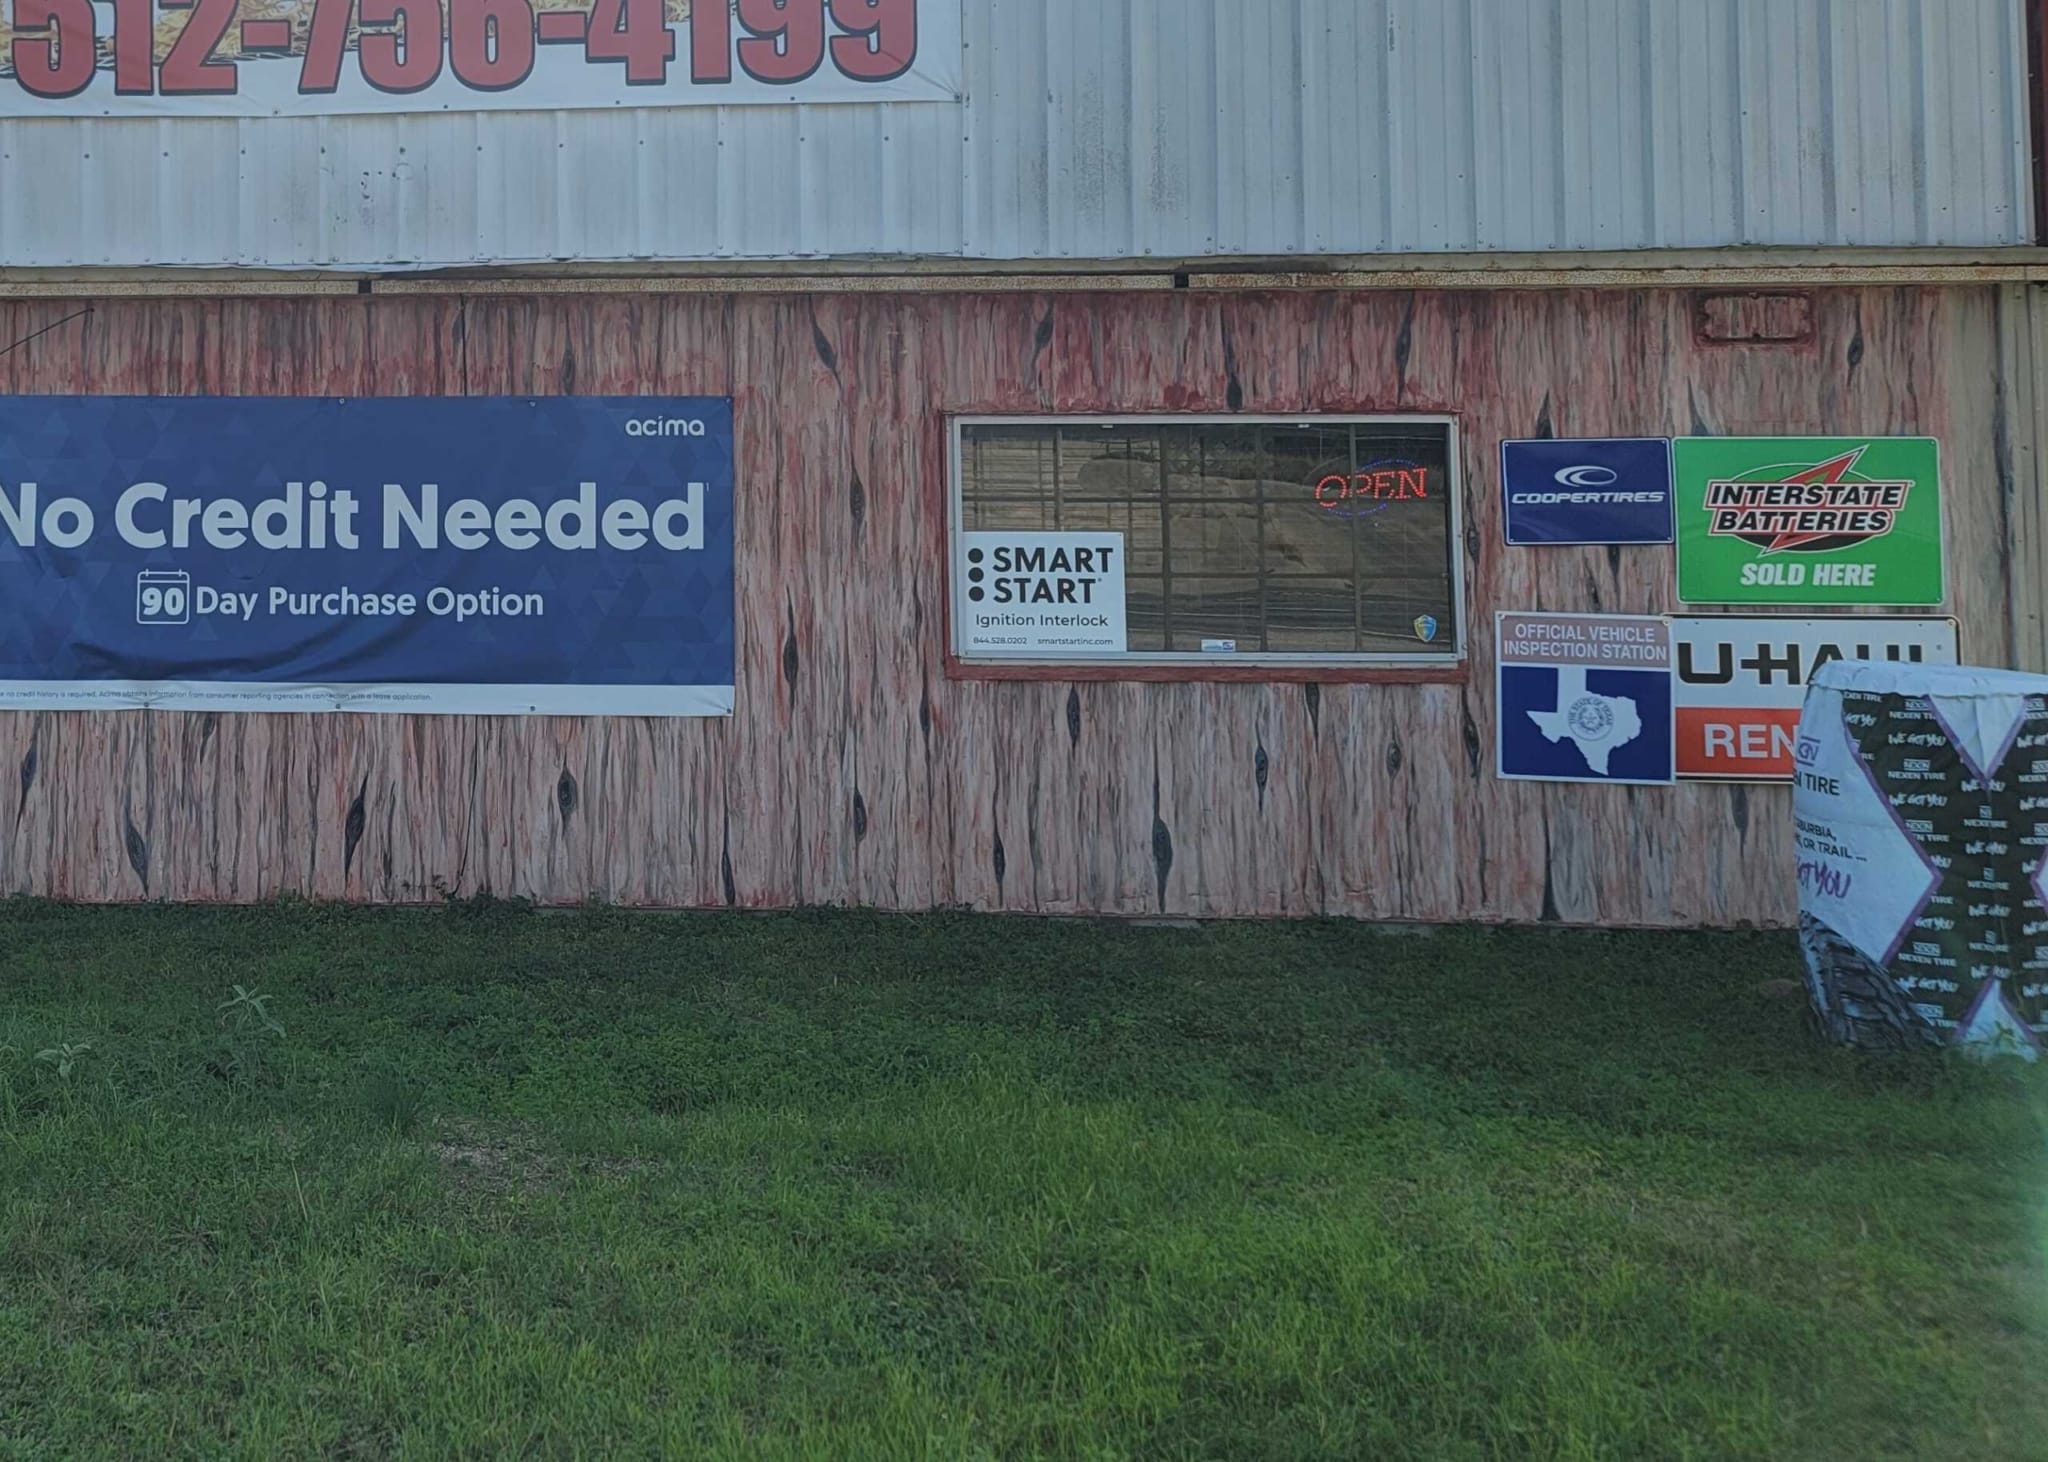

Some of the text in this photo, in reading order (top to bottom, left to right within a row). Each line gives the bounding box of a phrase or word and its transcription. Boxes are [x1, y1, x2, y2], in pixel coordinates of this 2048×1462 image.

[1314, 467, 1428, 508] OPEN
[1512, 491, 1665, 504] COOPERTIRES
[1709, 484, 1902, 506] INTERSTATE
[0, 482, 94, 549] No
[114, 481, 359, 549] Credit
[382, 482, 704, 550] Needed
[1716, 510, 1890, 531] BATTERIES
[992, 547, 1114, 573] SMART
[1740, 563, 1877, 586] SOLD HERE
[992, 577, 1097, 604] START
[141, 587, 544, 622] 90 Day Purchase Option
[975, 613, 1109, 628] Ignition Interlock
[973, 636, 1114, 646] 844.528.0202 smartstartinc.com
[1515, 623, 1656, 642] OFFICIAL VEHICLE
[1504, 640, 1667, 660] INSPECTION STATION
[1704, 723, 1799, 758] REN
[1804, 772, 1841, 796] TIRE
[1796, 818, 1837, 842] BURBIA,
[1817, 840, 1854, 860] TRAIL
[1814, 860, 1852, 899] YOU
